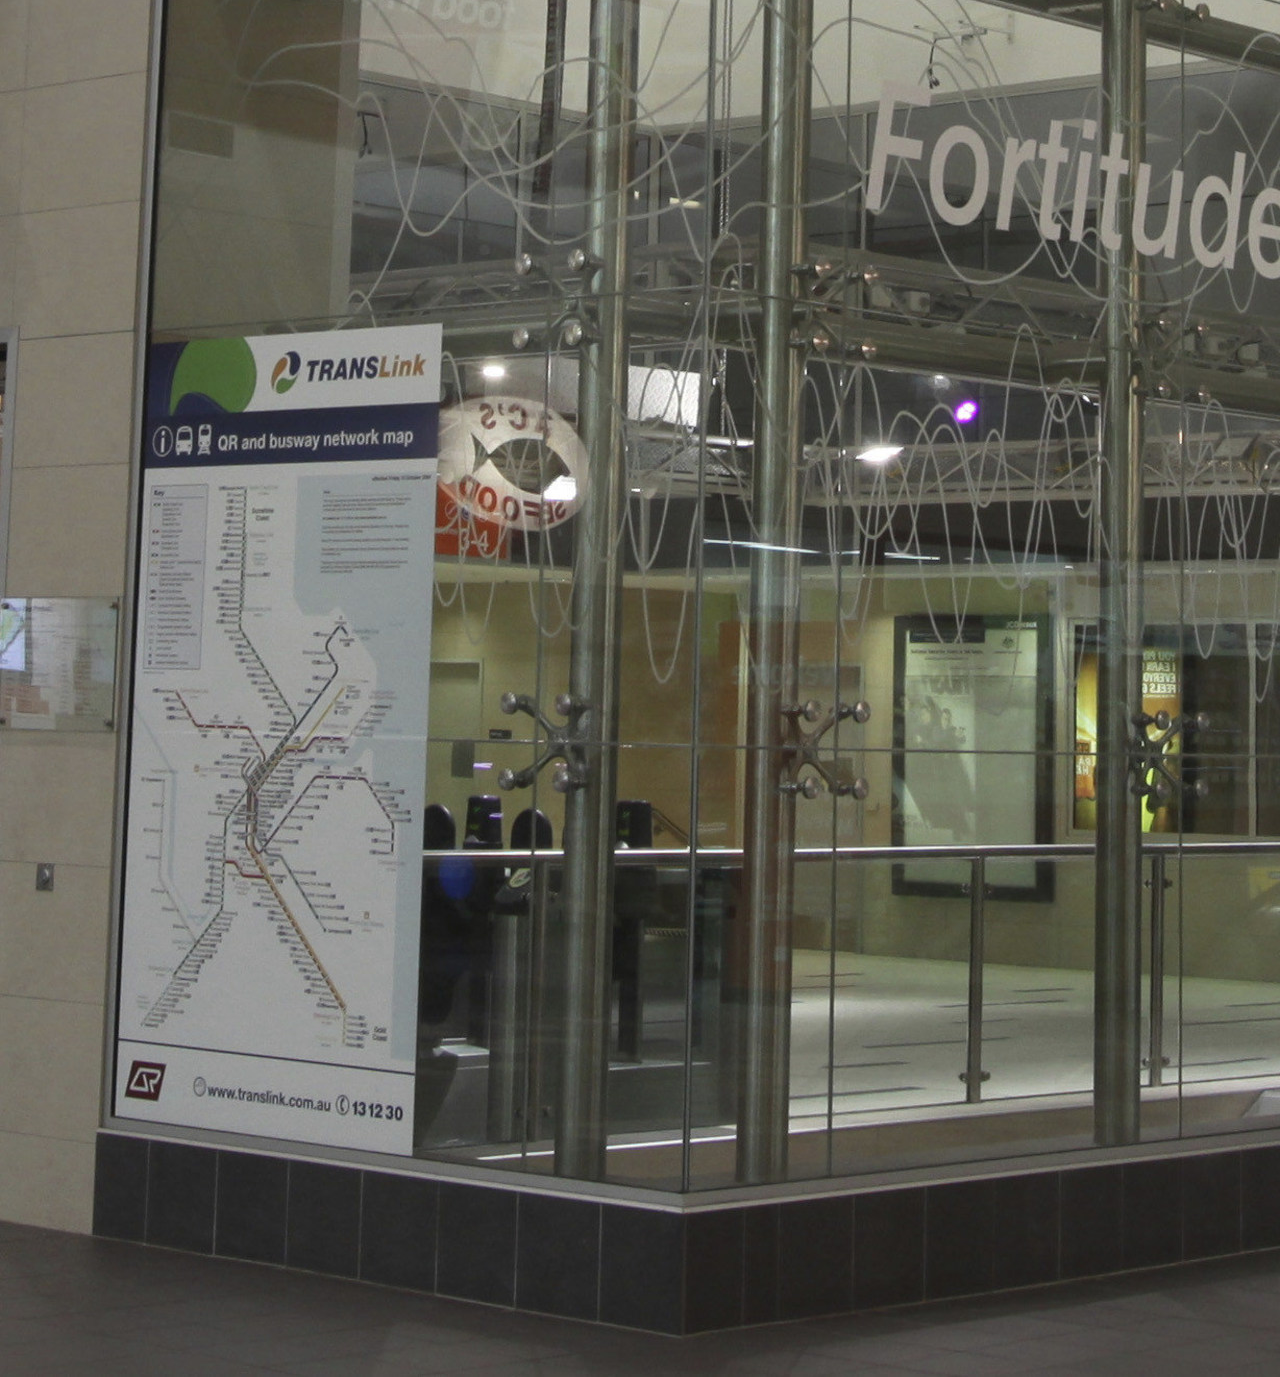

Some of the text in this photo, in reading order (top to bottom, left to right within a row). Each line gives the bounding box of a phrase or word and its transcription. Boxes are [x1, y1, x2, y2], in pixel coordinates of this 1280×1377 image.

[306, 353, 427, 382] TRANSLink
[218, 428, 413, 451] QR and busway network map
[207, 1085, 331, 1113] www.translink.com.au
